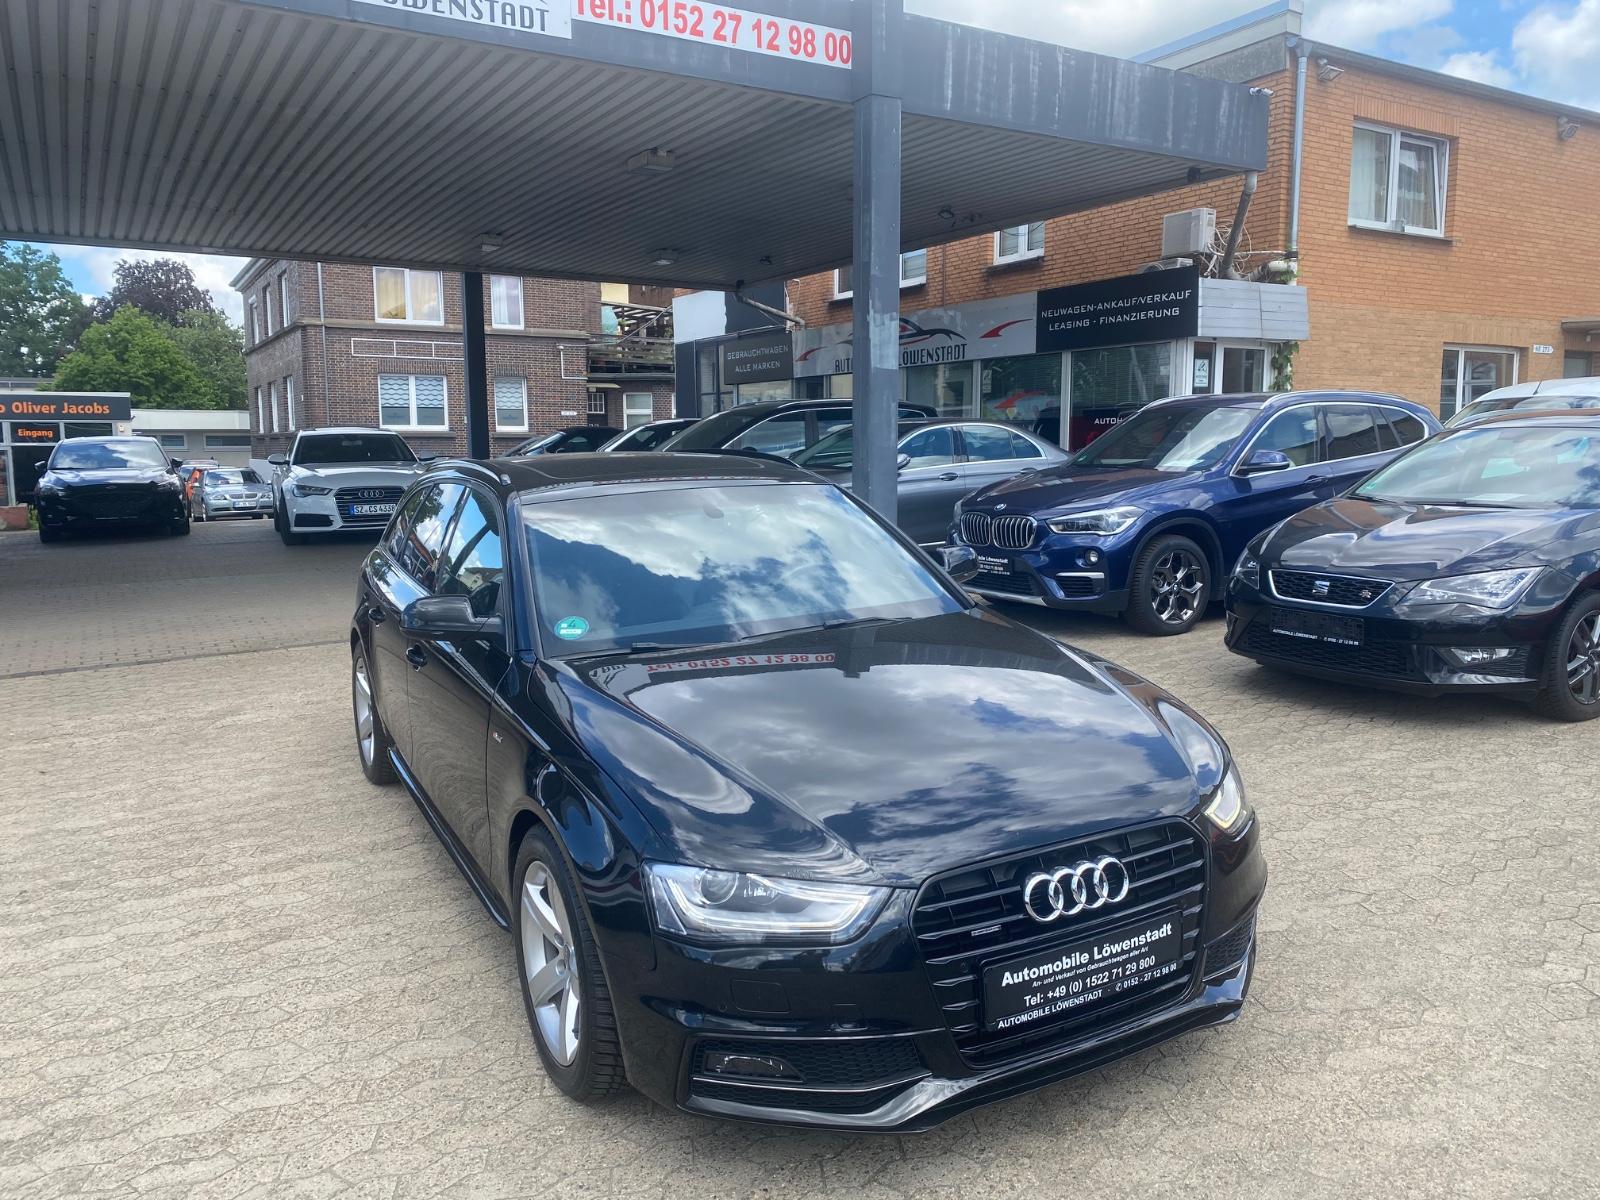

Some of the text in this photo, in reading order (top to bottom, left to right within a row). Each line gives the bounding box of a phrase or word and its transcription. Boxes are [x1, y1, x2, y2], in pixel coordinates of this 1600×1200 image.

[640, 0, 704, 37] 0152
[712, 10, 742, 44] 27
[752, 18, 780, 52] 12
[788, 25, 816, 58] 98
[824, 32, 852, 65] 00
[1041, 289, 1191, 318] NEUWAGEN-ANKAUF/VERKAUF
[1049, 318, 1090, 331] LEASING
[1100, 307, 1180, 325] FINANZIERUNG
[727, 345, 789, 360] GEBRAUCHTWAGEN
[899, 344, 967, 366] ÖWENSTADT
[735, 361, 781, 373] ALLE MARKEN
[12, 401, 56, 414] Oliver
[62, 402, 110, 414] Jacobs
[18, 428, 53, 438] Eingang
[1001, 922, 1172, 987] Automobile Löwenstadt
[1024, 955, 1155, 1007] Tel: +49 (0) 1522 71 29 800
[1043, 976, 1055, 985] und
[1055, 969, 1076, 981] Verkauf
[1076, 967, 1086, 975] von
[998, 1006, 1050, 1029] AUTOMOBILE
[1052, 989, 1102, 1013] LÖWENSTADT
[1123, 977, 1138, 988] 0152
[1144, 972, 1151, 981] 27
[1153, 970, 1160, 978] 12
